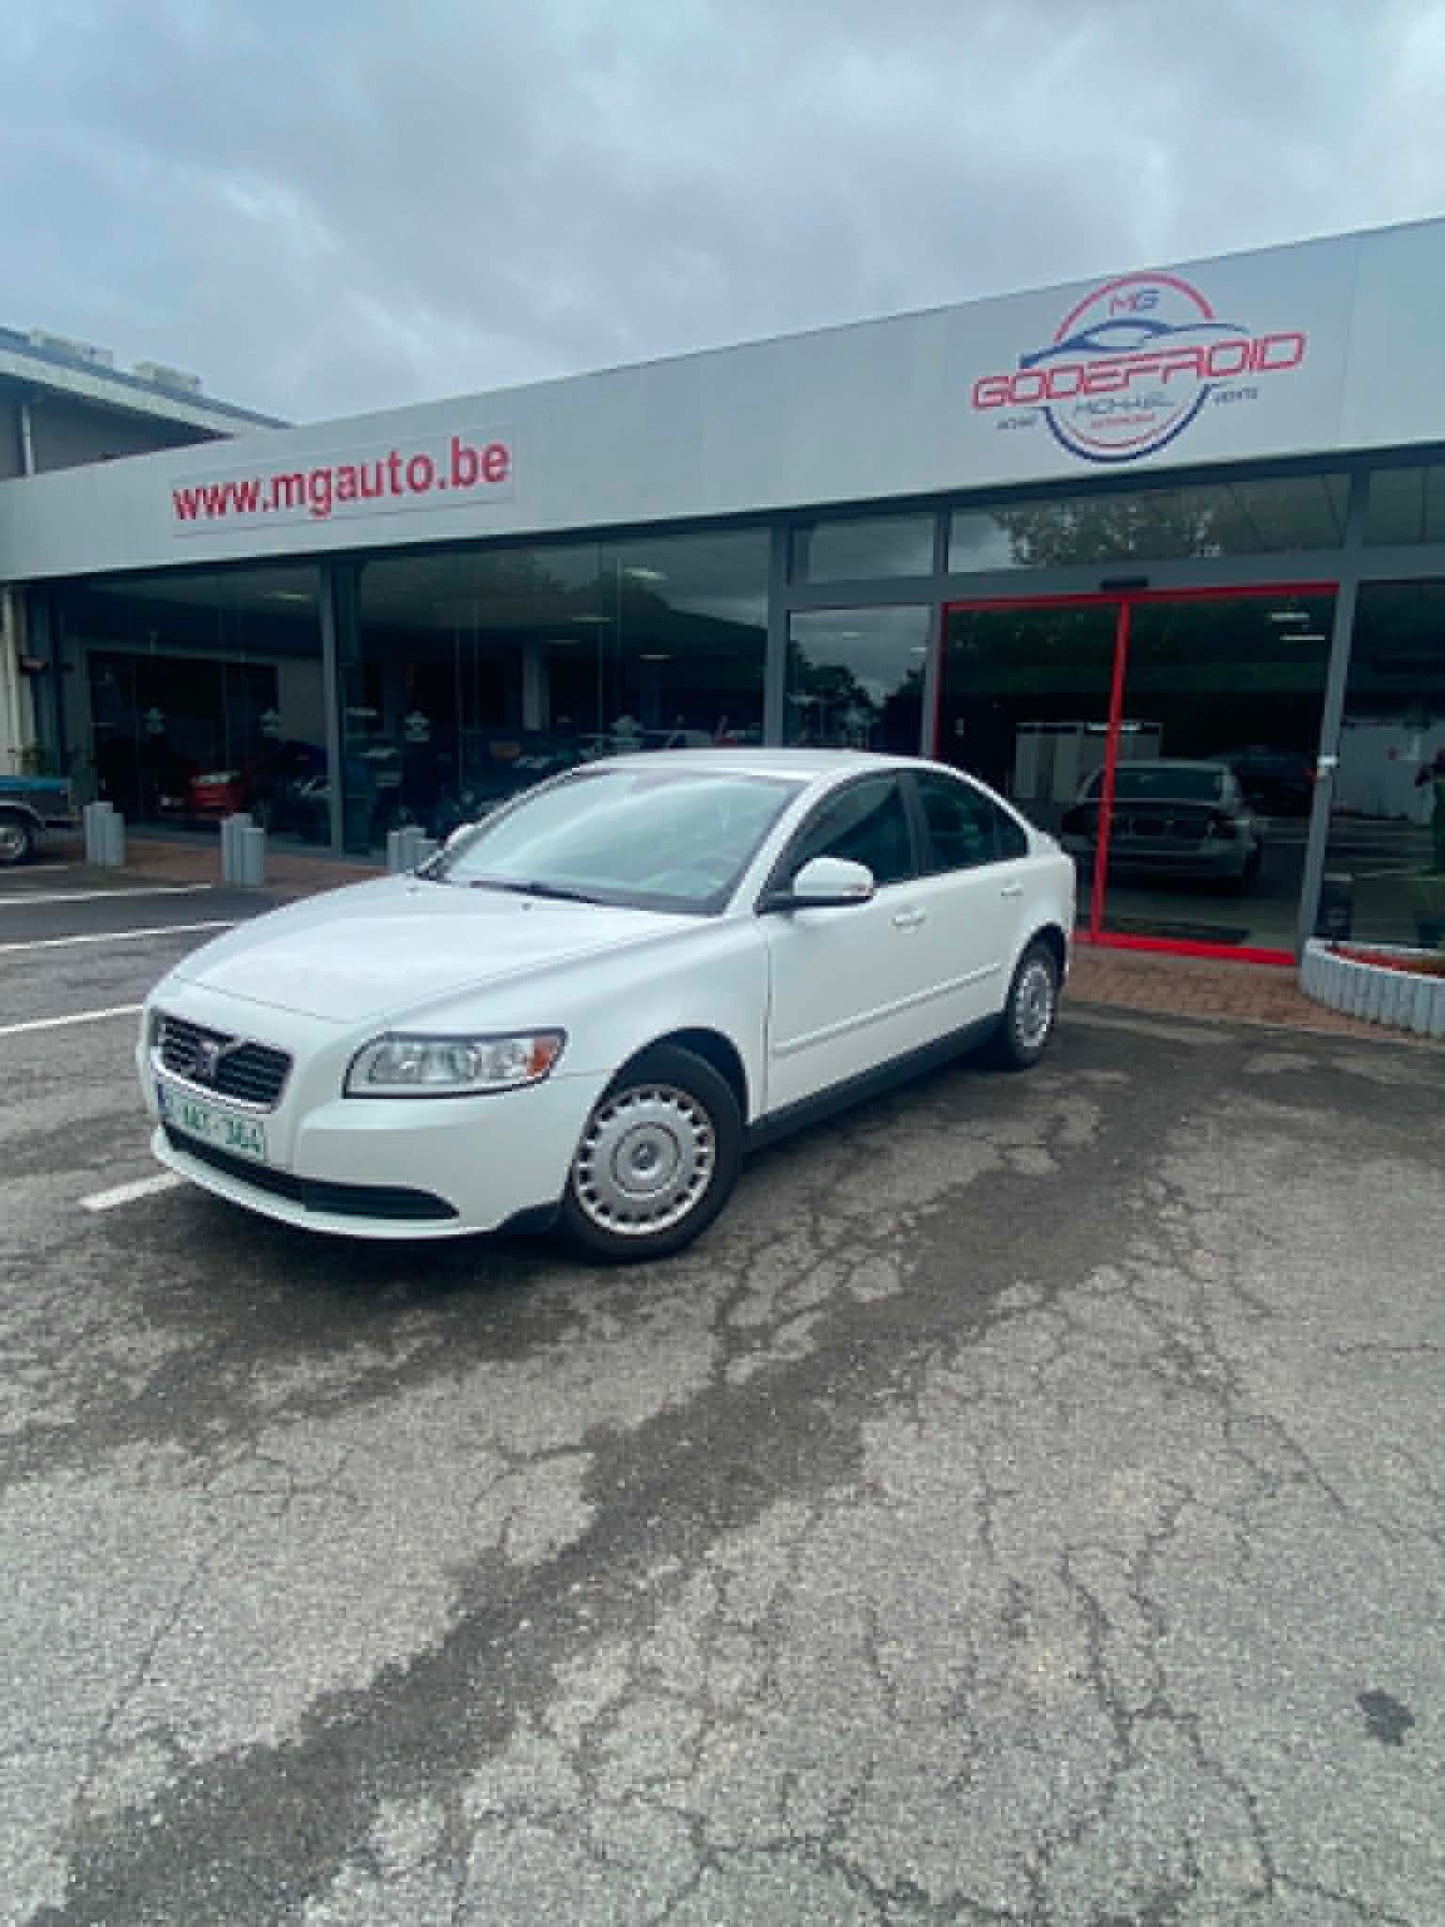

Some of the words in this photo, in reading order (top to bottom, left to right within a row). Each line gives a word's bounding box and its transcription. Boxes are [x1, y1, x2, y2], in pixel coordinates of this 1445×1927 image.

[1110, 289, 1159, 317] MG
[971, 331, 1306, 410] GODEFROID
[172, 436, 511, 519] www.mgauto.be
